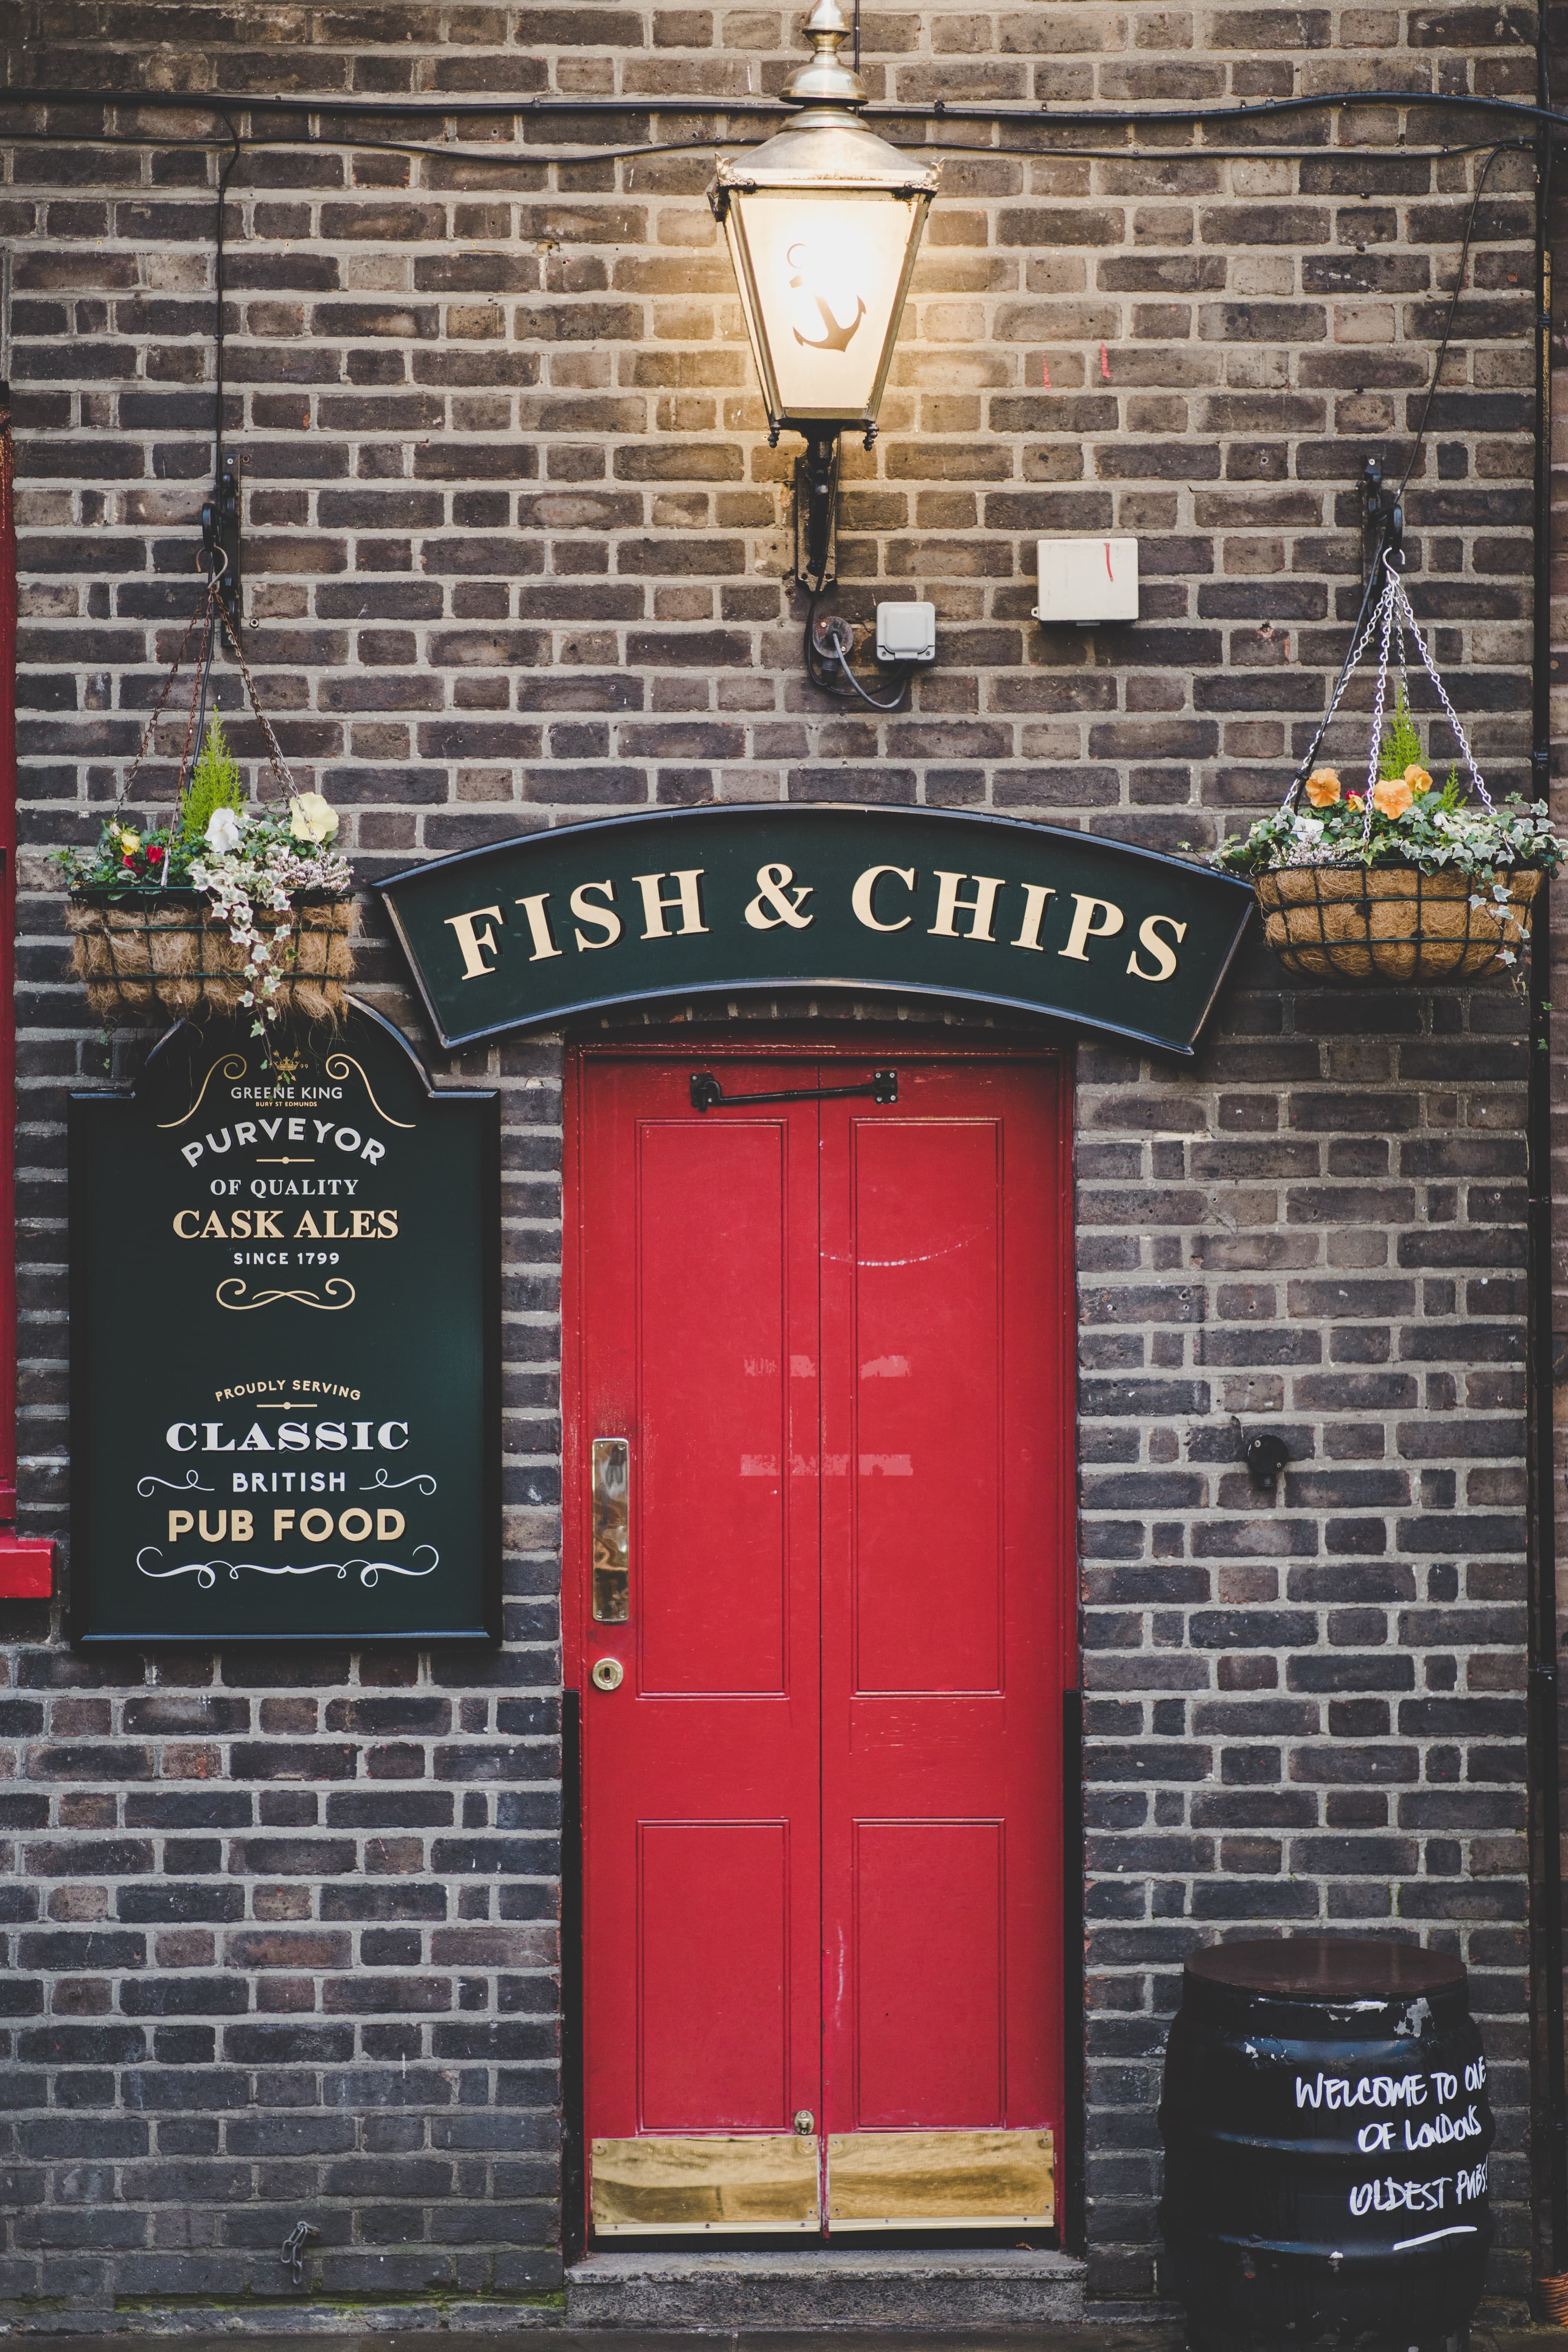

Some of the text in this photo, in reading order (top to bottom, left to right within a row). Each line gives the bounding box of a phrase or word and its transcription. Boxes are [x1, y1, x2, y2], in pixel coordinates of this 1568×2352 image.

[444, 863, 1187, 982] FISH & CHIPS
[231, 1087, 342, 1099] GREENE KING
[180, 1117, 386, 1168] PURVEYOR
[210, 1179, 359, 1199] OF QUALITY
[172, 1209, 399, 1239] CASK ALES
[233, 1252, 340, 1265] SINCE 1799
[215, 1379, 361, 1403] PROUDLY SERVING
[166, 1421, 409, 1451] CLASSIC
[233, 1471, 345, 1493] BRITISH
[168, 1507, 405, 1542] PUB FOOD
[1296, 2055, 1486, 2110] WELCOME TO ONE
[1357, 2122, 1397, 2153] OF
[1349, 2177, 1453, 2216] OLDEST
